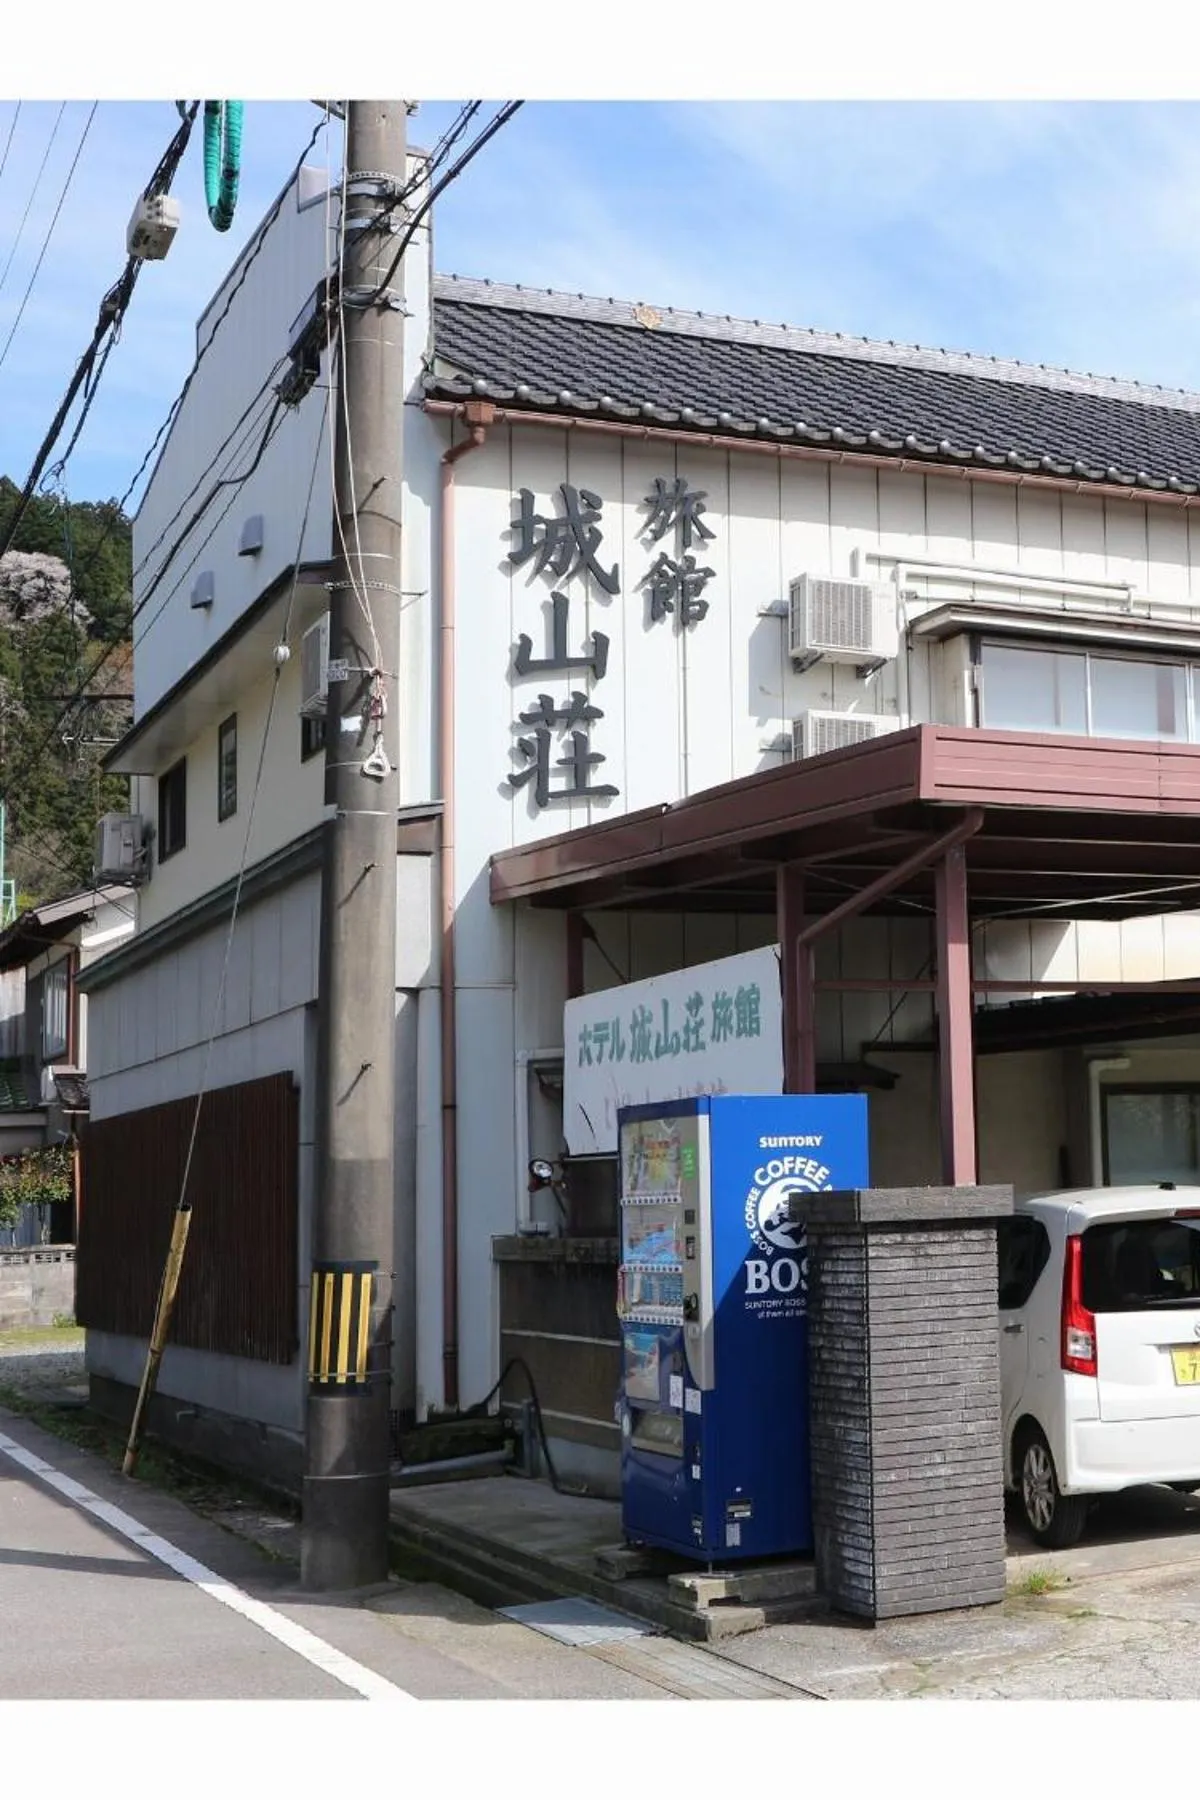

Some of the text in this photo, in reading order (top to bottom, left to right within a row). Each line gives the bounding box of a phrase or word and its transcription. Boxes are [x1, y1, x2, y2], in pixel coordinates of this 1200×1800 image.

[507, 483, 621, 808] 城山荘
[759, 1135, 823, 1148] SUNTORY
[754, 1156, 830, 1186] COFFEE
